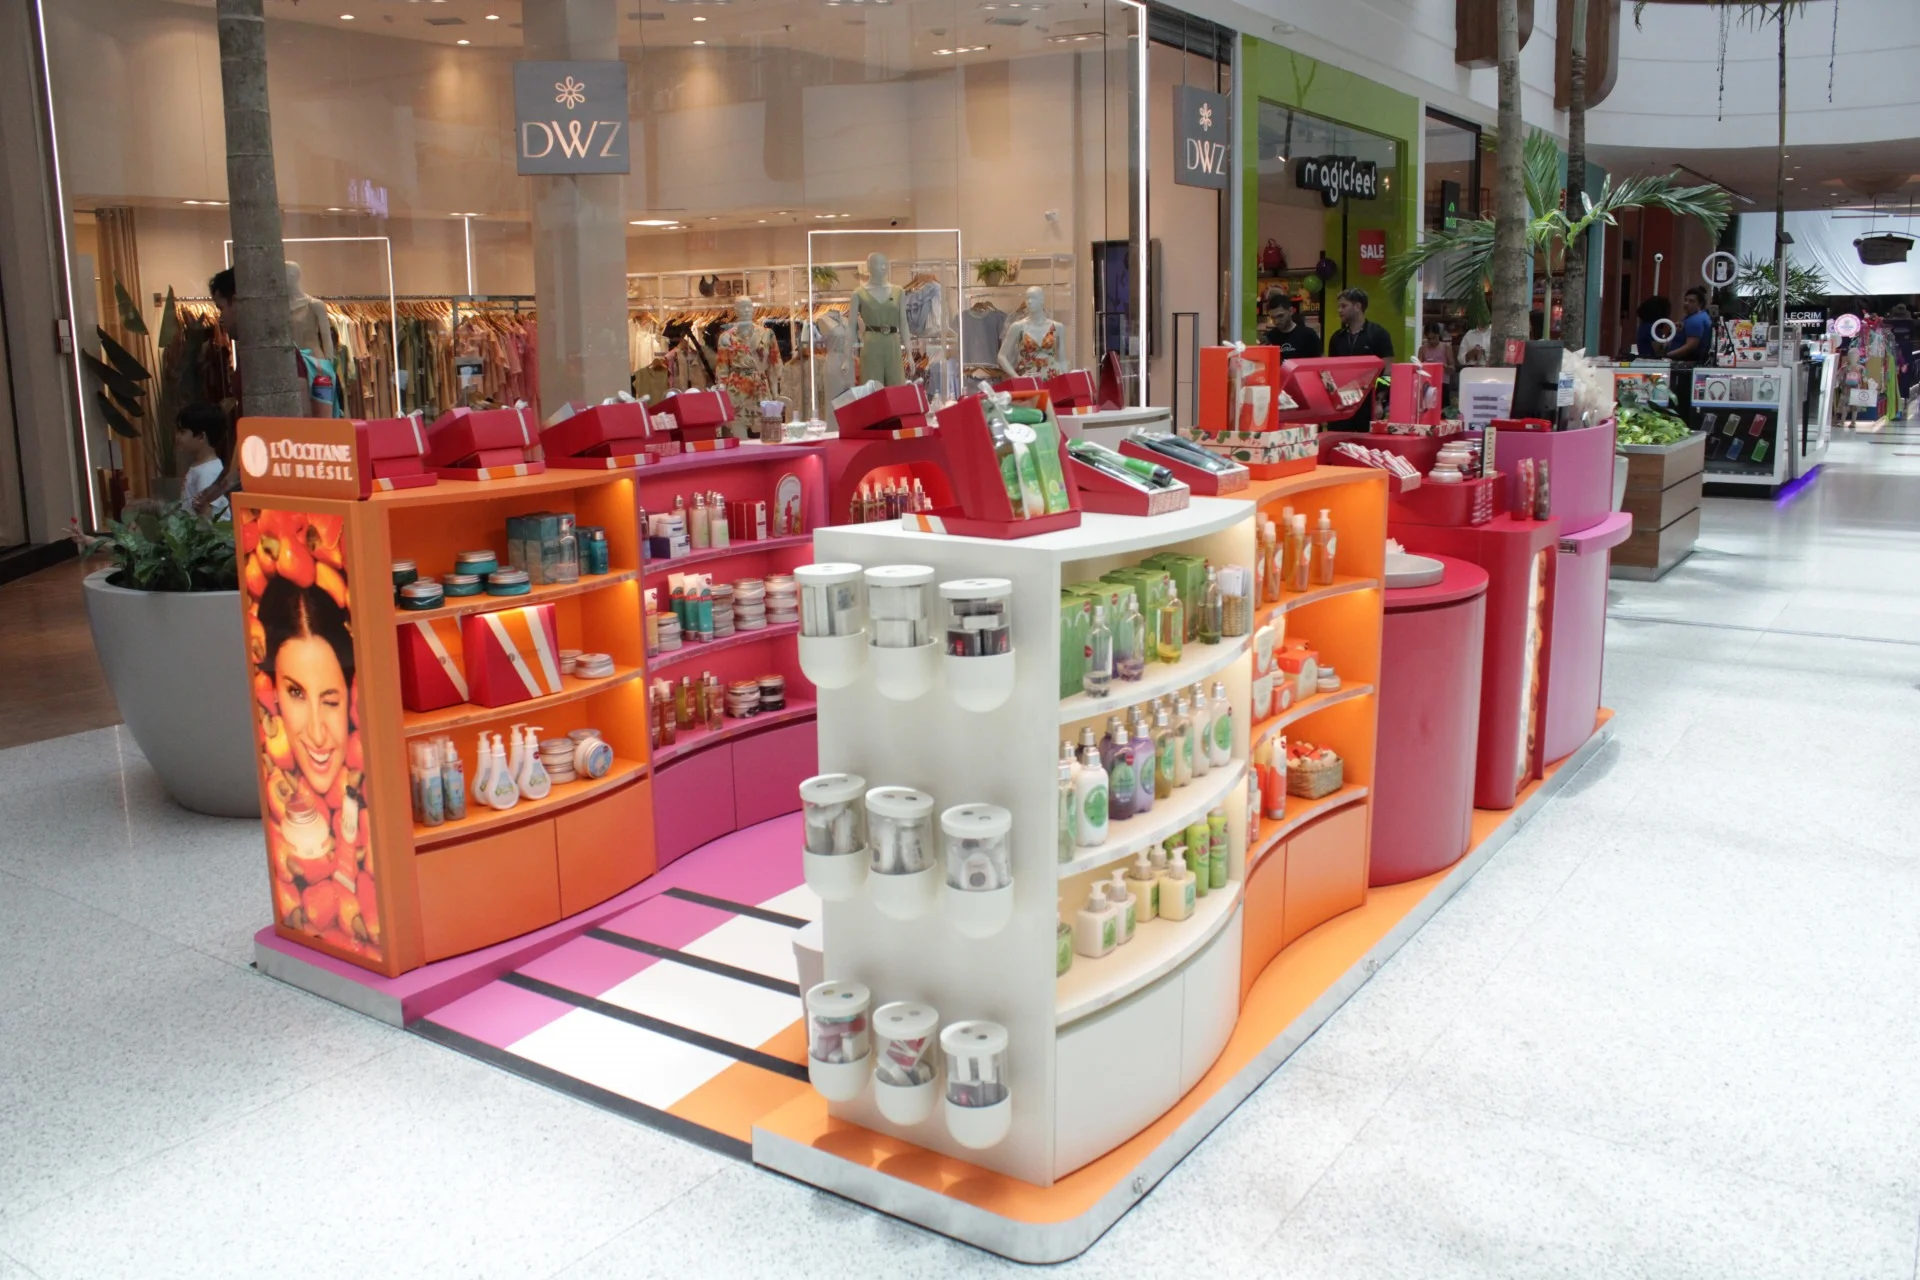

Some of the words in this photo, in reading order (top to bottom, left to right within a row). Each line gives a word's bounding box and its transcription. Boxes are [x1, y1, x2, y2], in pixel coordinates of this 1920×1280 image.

[522, 120, 622, 158] DWZ
[1187, 138, 1226, 175] DWZ
[1305, 161, 1376, 202] magicfeet
[1360, 244, 1384, 259] SALE
[1784, 311, 1822, 320] LECRIM
[270, 439, 351, 462] L'OCCITANE
[272, 463, 291, 477] AU
[295, 462, 353, 481] BRÉSIL
